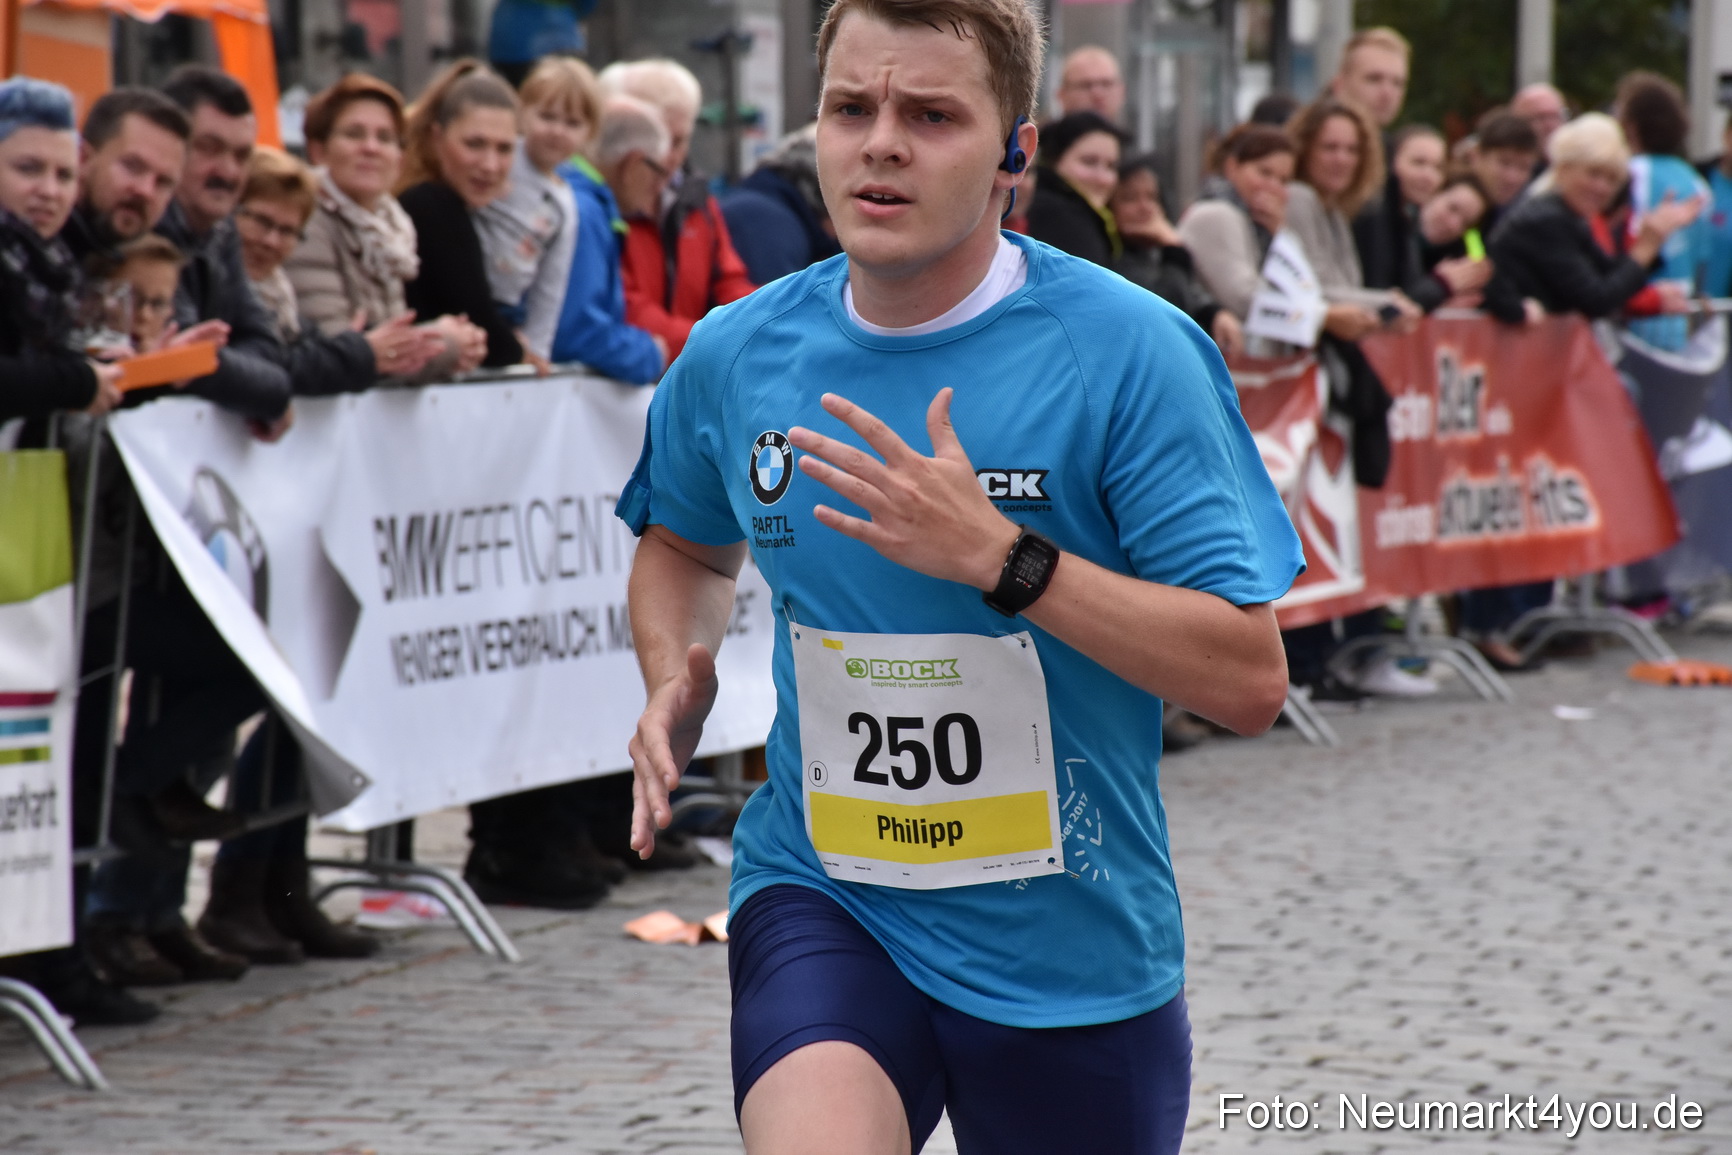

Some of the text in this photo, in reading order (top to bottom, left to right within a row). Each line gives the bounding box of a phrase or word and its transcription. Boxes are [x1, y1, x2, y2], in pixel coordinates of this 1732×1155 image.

[753, 433, 791, 457] BMW
[975, 468, 1051, 501] CK
[1003, 504, 1052, 512] concepts
[752, 516, 794, 534] PARTL
[755, 535, 795, 548] Neumarkt
[869, 658, 961, 680] BOCK
[871, 680, 897, 688] inspired
[898, 681, 906, 689] by
[930, 679, 963, 688] concepts
[848, 712, 982, 790] 250
[814, 767, 822, 781] D
[1069, 792, 1088, 822] 2017
[877, 814, 963, 848] Philipp
